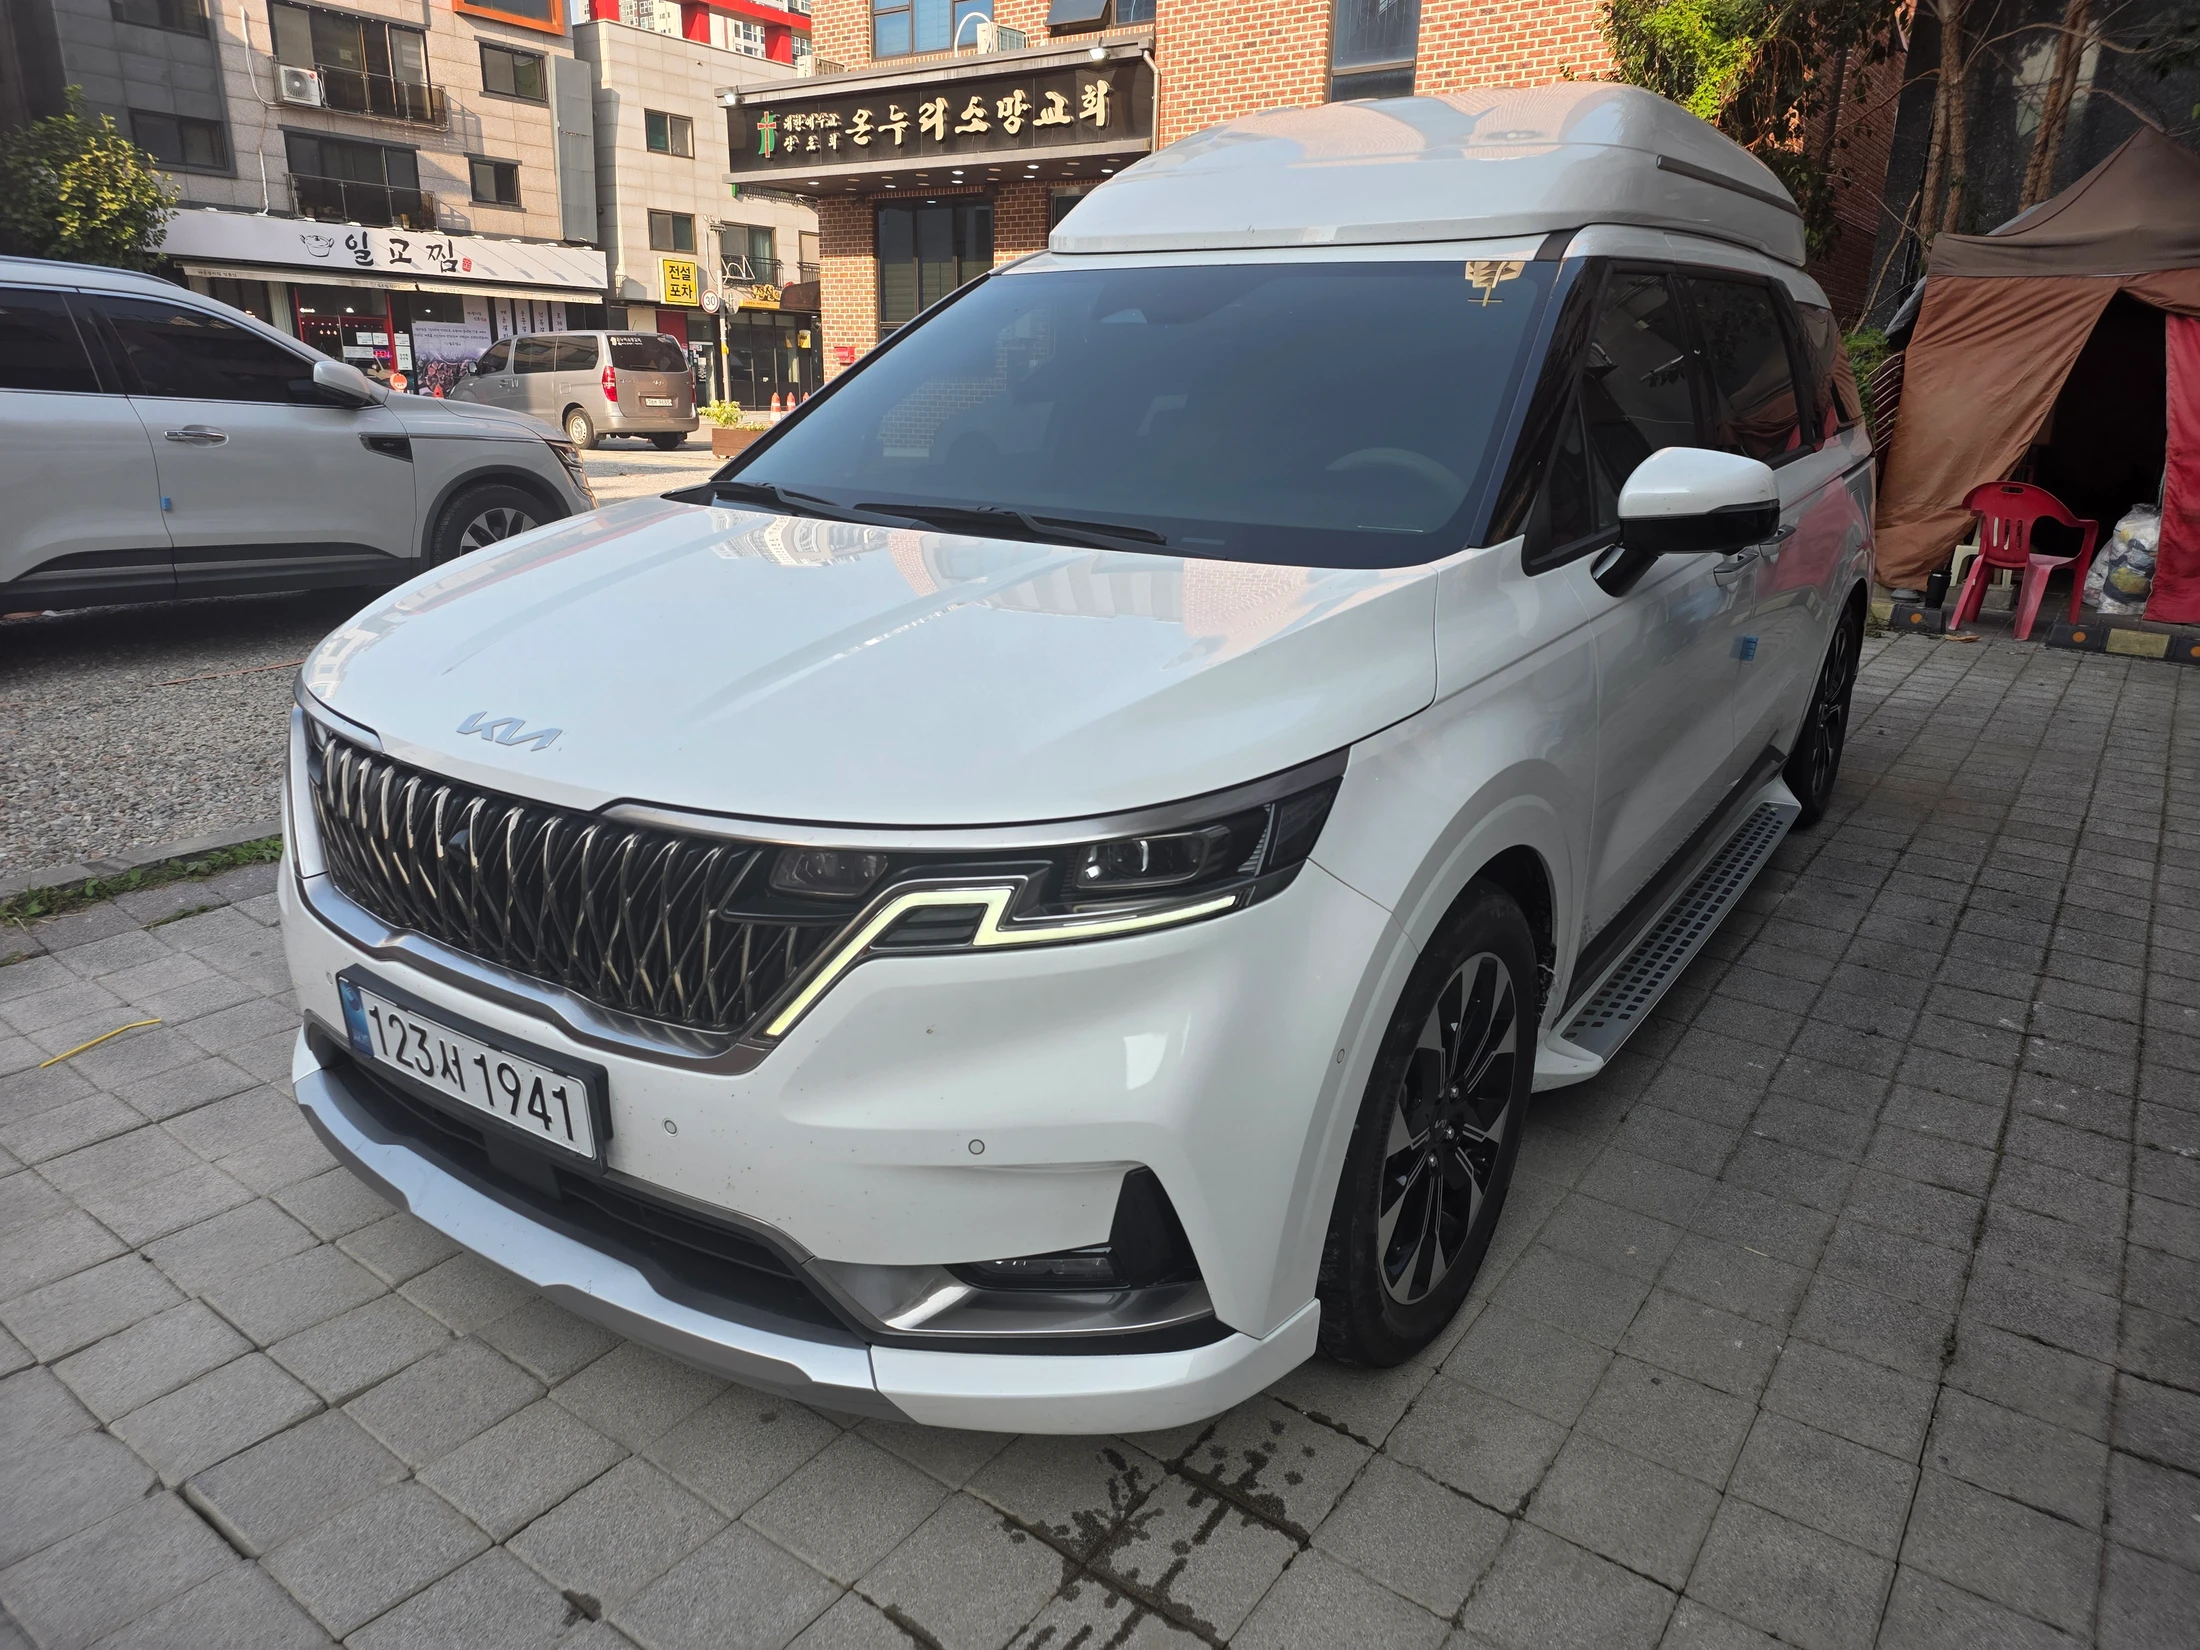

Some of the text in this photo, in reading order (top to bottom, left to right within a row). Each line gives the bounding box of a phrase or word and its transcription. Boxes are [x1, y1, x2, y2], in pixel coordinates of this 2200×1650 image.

[783, 112, 841, 132] 대한예수교
[844, 79, 1112, 146] 온누리소망교회
[783, 132, 840, 153] 장로회
[668, 265, 691, 281] 전설
[669, 284, 693, 299] 포차
[705, 296, 716, 307] 30
[368, 1003, 576, 1142] 123서 1941
